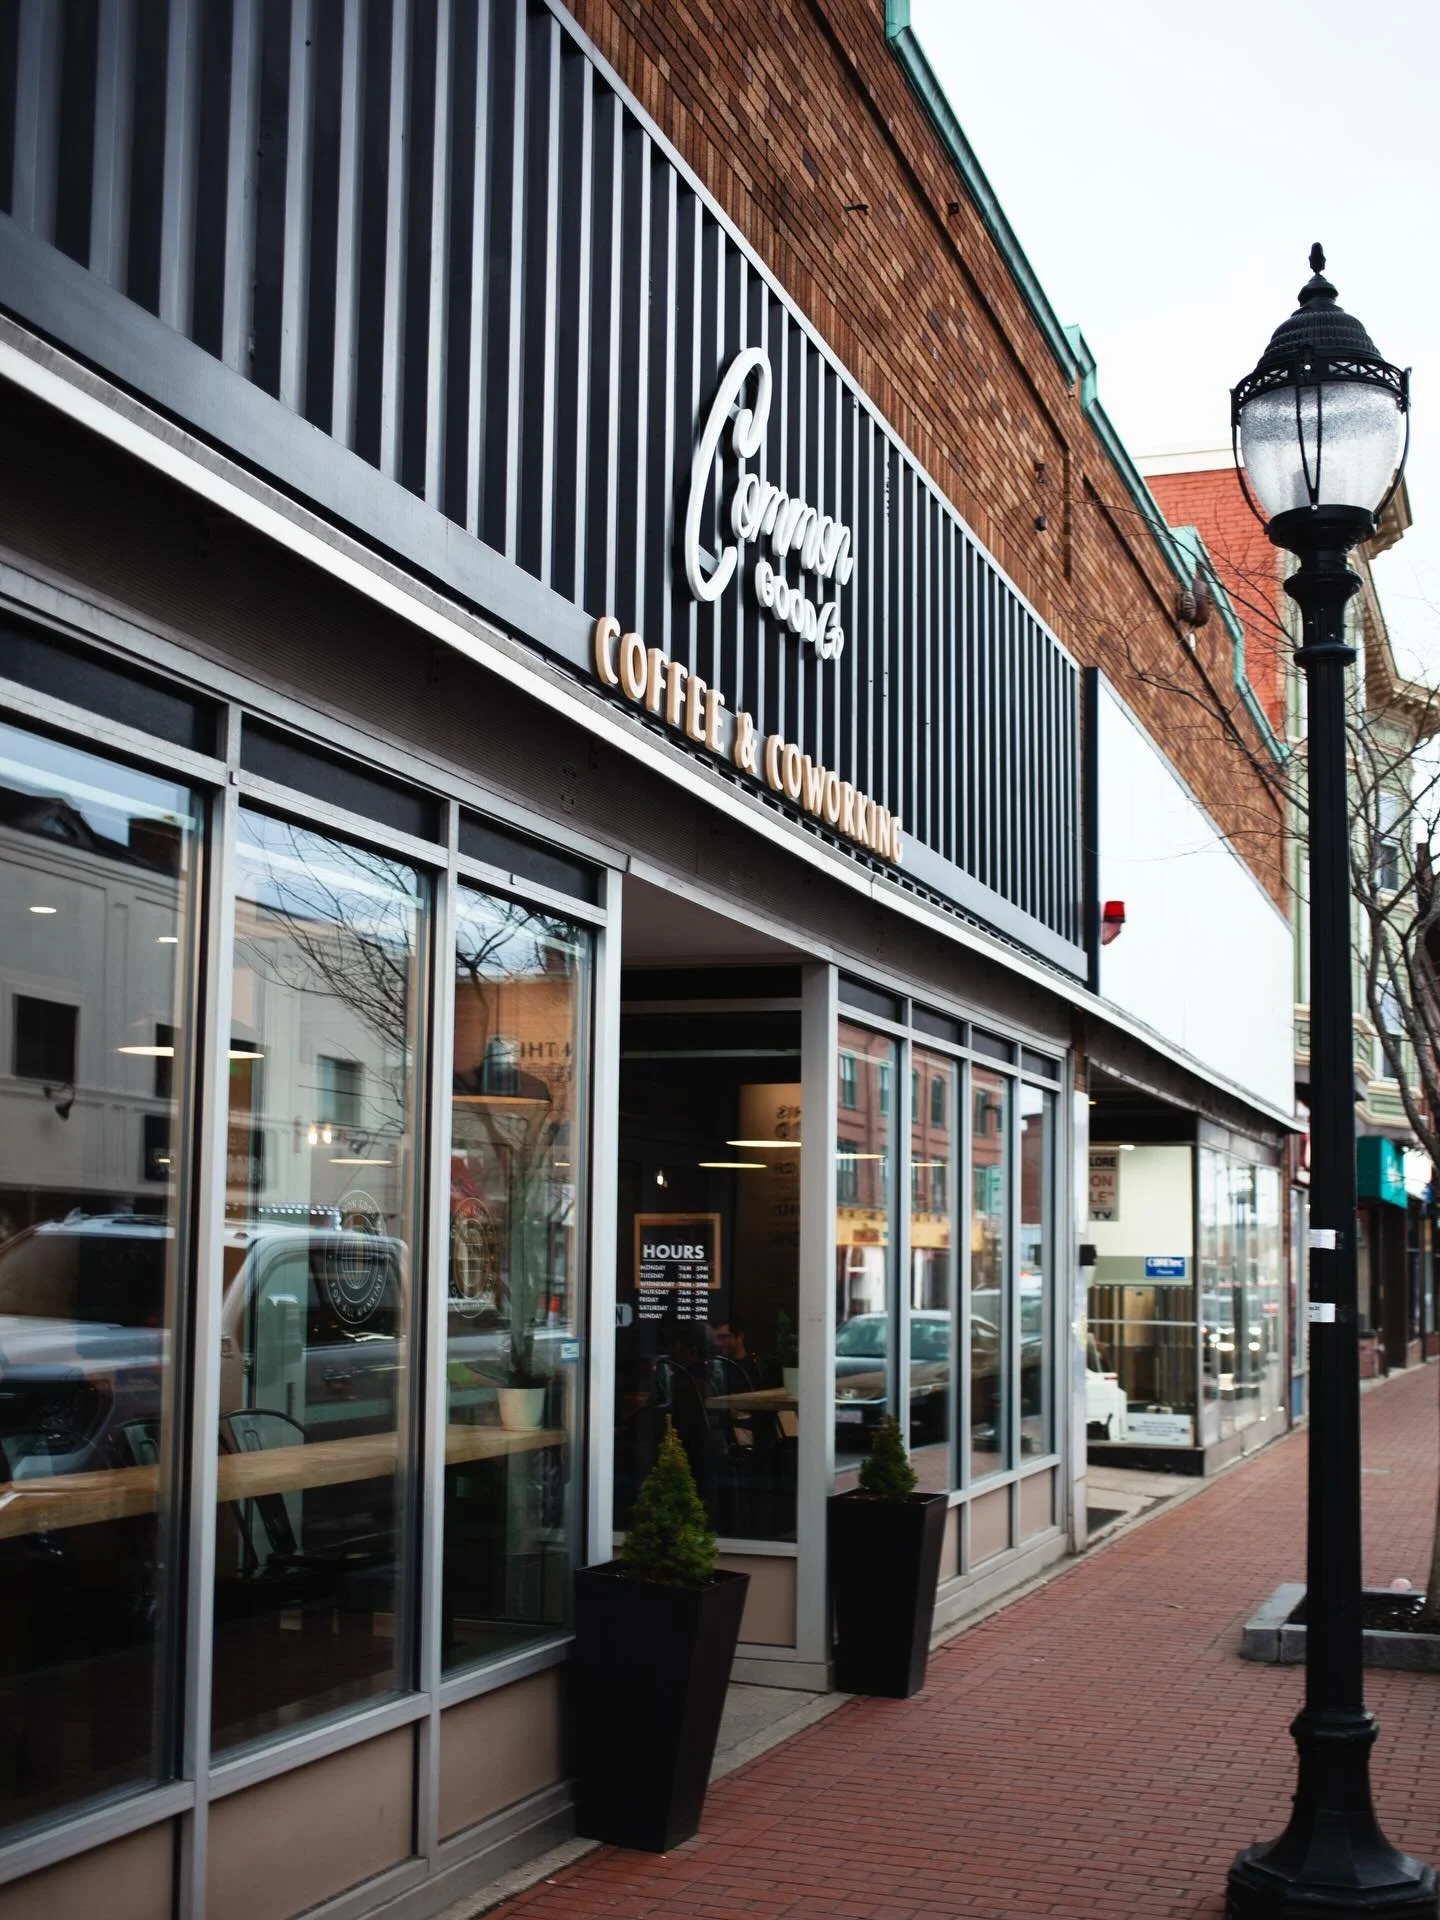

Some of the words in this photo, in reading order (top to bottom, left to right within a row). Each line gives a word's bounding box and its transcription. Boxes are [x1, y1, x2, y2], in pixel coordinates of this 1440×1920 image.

[595, 616, 726, 753] COFFEE
[734, 712, 757, 774] &
[766, 734, 903, 864] COWORKING
[643, 1244, 705, 1259] HOURS
